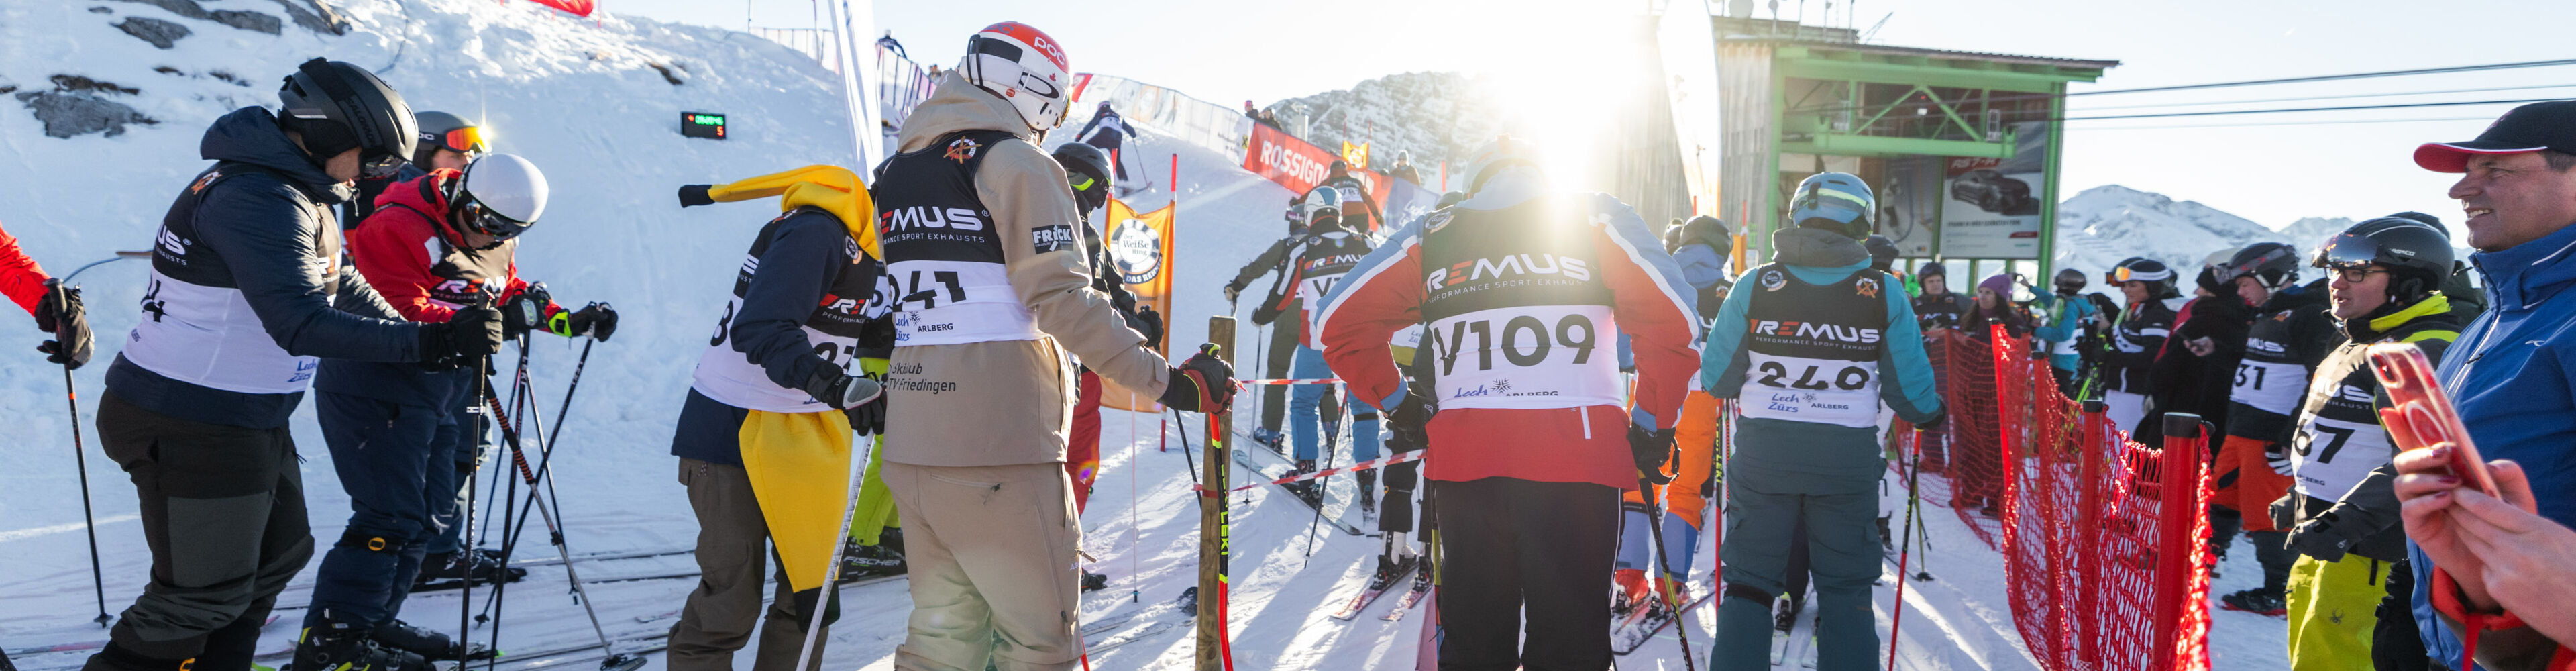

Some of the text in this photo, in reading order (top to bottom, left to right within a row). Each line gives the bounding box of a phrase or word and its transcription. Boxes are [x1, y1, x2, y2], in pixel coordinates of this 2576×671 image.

[417, 132, 435, 140] OC
[1260, 140, 1330, 187] ROSSIGN
[881, 206, 983, 235] EMUS
[902, 232, 924, 241] SPORT
[928, 233, 985, 243] EXHAUSTS
[1426, 253, 1591, 295] REMUS
[1495, 278, 1531, 289] SPORT
[918, 323, 953, 333] ARLBERG
[1756, 320, 1880, 343] REMUS
[1434, 313, 1595, 376] V109
[1756, 336, 1809, 346] PERFORMANCE
[2234, 364, 2266, 391] 31
[898, 378, 956, 395] Friedingen
[1771, 393, 1799, 403] Lech
[1768, 402, 1799, 413] Zürs
[1220, 511, 1230, 556] LEKI
[843, 556, 901, 566] FISCHER
